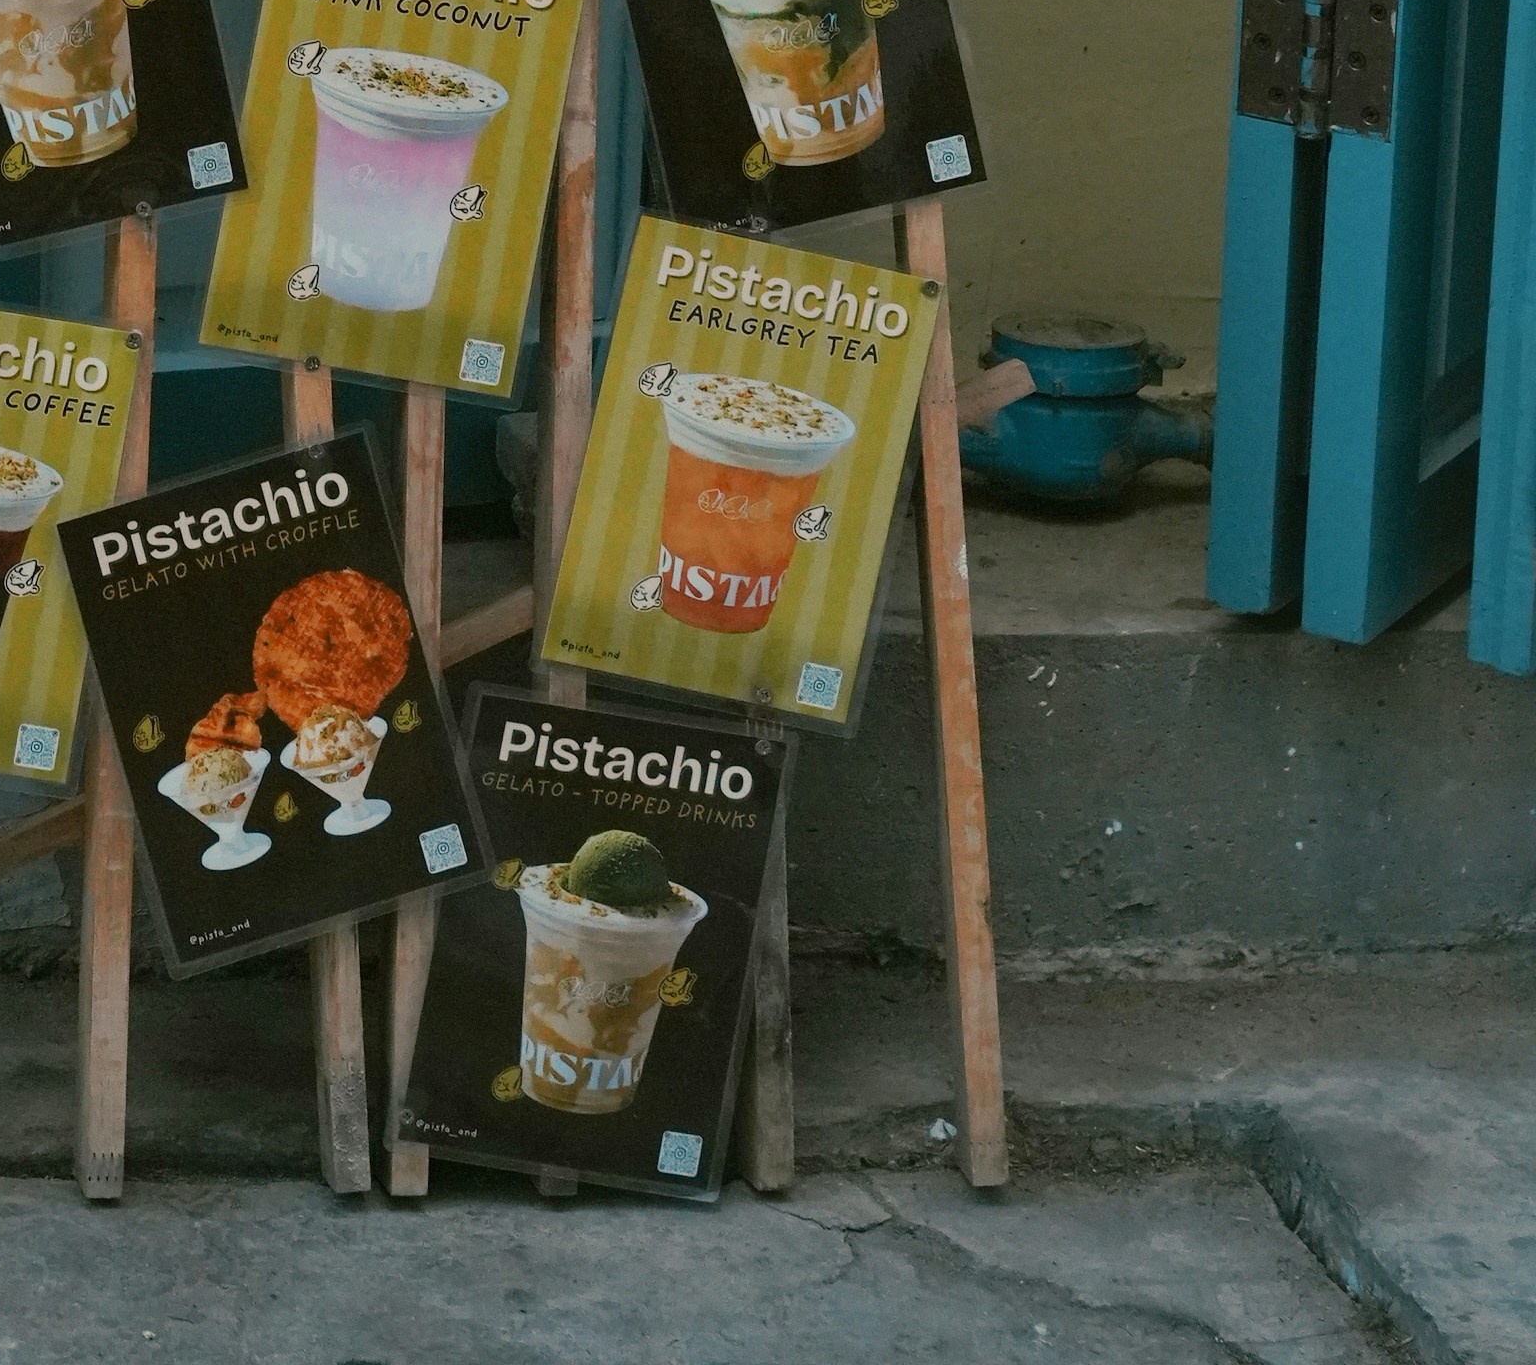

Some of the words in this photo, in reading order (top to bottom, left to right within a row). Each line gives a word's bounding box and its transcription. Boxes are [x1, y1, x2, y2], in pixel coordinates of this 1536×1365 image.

[657, 244, 909, 339] Pistachio
[668, 299, 816, 350] EARLGREY
[827, 333, 880, 365] TEA
[4, 389, 116, 427] COFFEE
[92, 468, 349, 576] Pistachio
[103, 562, 188, 601] GELATO
[196, 540, 258, 572] WITH
[265, 508, 362, 552] CROFFLE
[482, 770, 565, 798] GELATO
[592, 788, 671, 816] TOPPED
[678, 800, 758, 830] DRINKS
[498, 719, 754, 801] Pistachio
